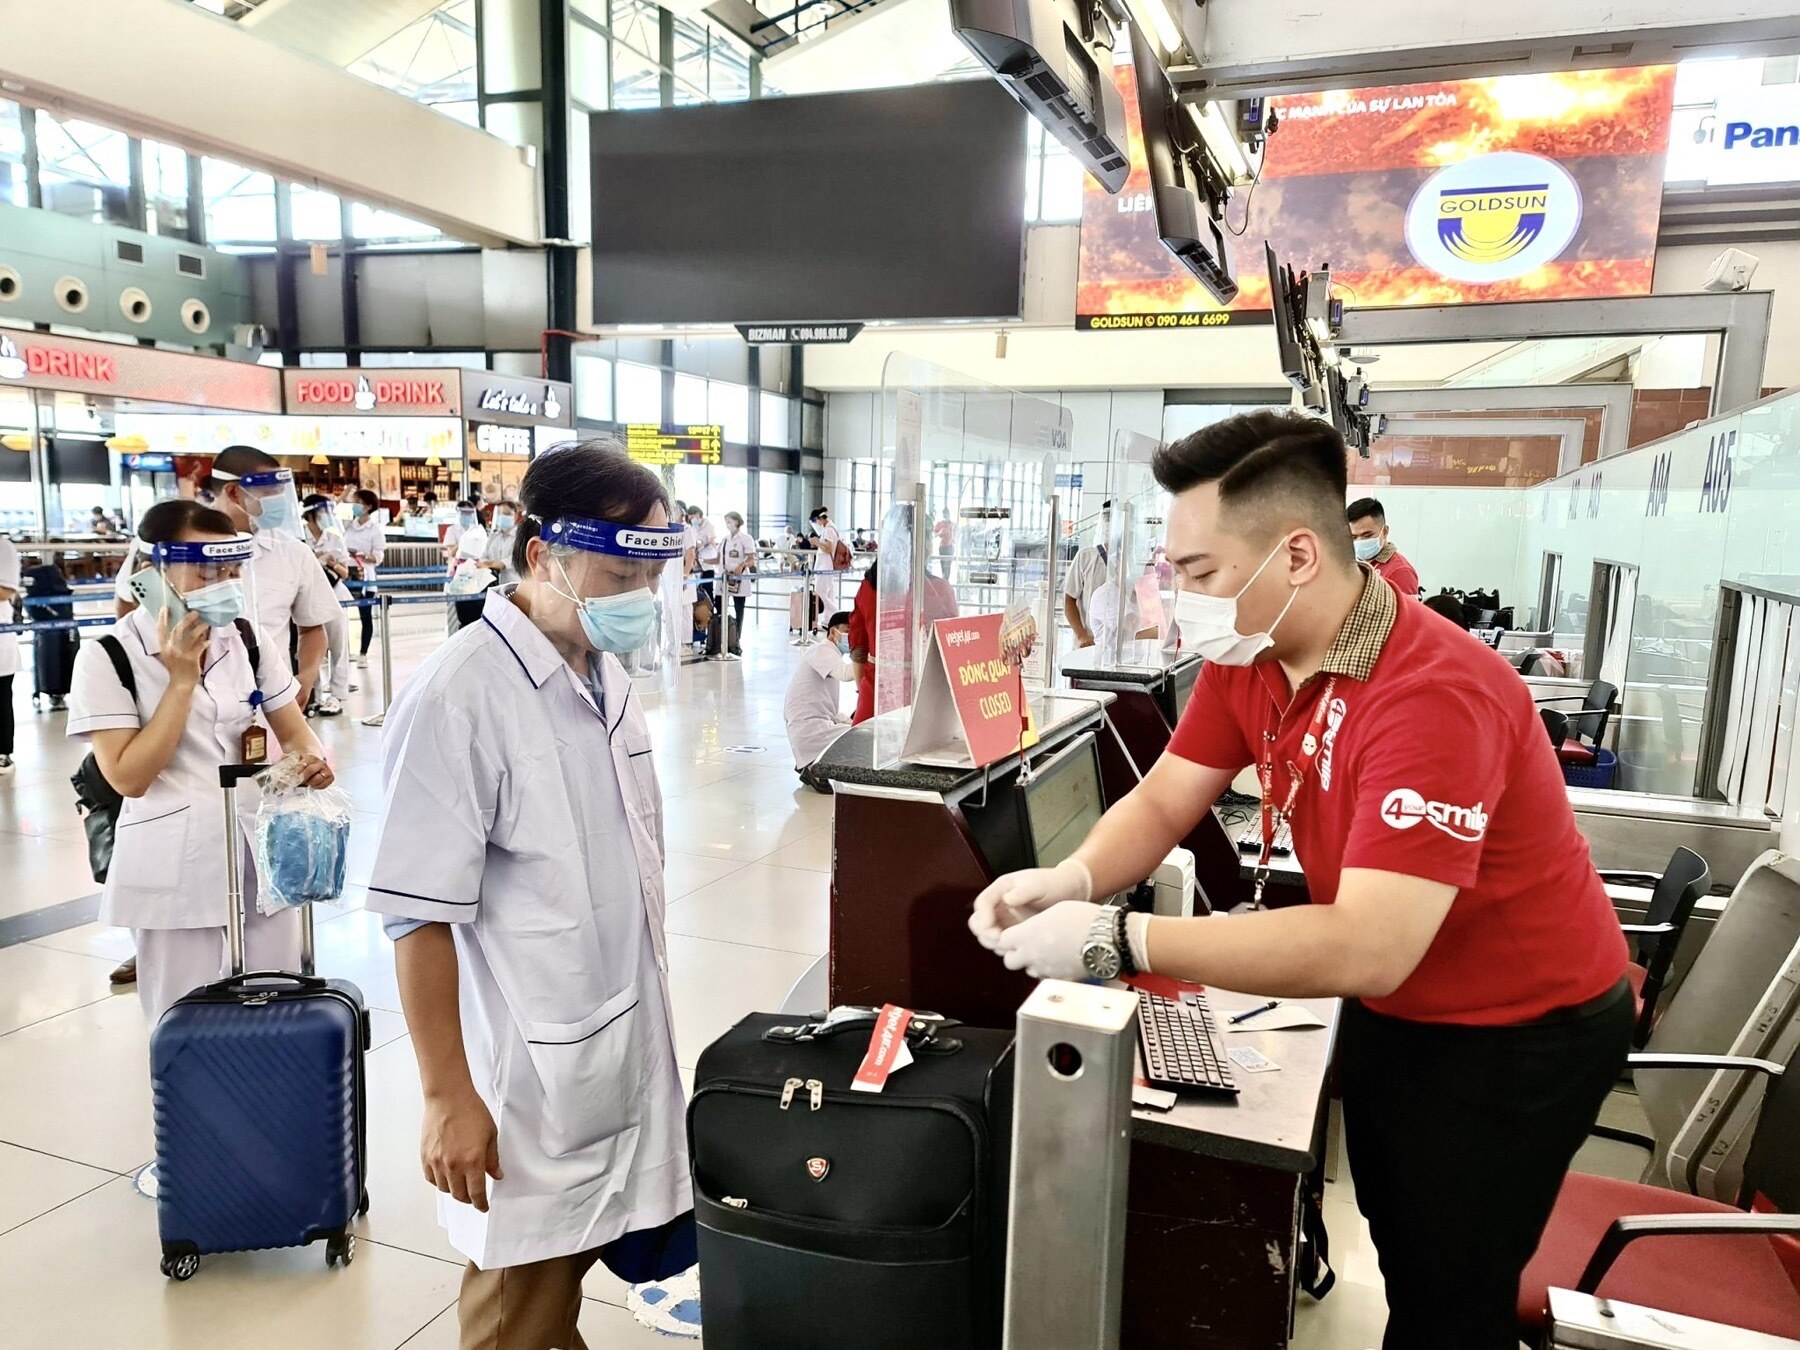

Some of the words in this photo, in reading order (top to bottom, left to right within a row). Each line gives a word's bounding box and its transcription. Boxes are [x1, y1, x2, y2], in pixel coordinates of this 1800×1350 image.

[1369, 97, 1391, 113] SỰ
[1393, 95, 1424, 111] LAN
[1724, 121, 1800, 149] Pan
[1440, 195, 1546, 213] GOLDSUN
[1090, 316, 1143, 328] GOLDSUN
[1157, 315, 1177, 327] 090
[1179, 314, 1200, 326] 464
[1202, 313, 1230, 326] 6699
[748, 328, 786, 340] BIZMAN
[25, 346, 116, 381] DRINK
[297, 380, 355, 403] FOOD
[376, 381, 443, 404] DRINK
[477, 424, 531, 454] COFFEE
[1699, 430, 1737, 513] A05
[209, 546, 233, 554] Face
[625, 533, 658, 546] Face
[958, 660, 989, 687] ĐÓNG
[980, 691, 1012, 719] CLOSED
[1427, 800, 1488, 831] smile
